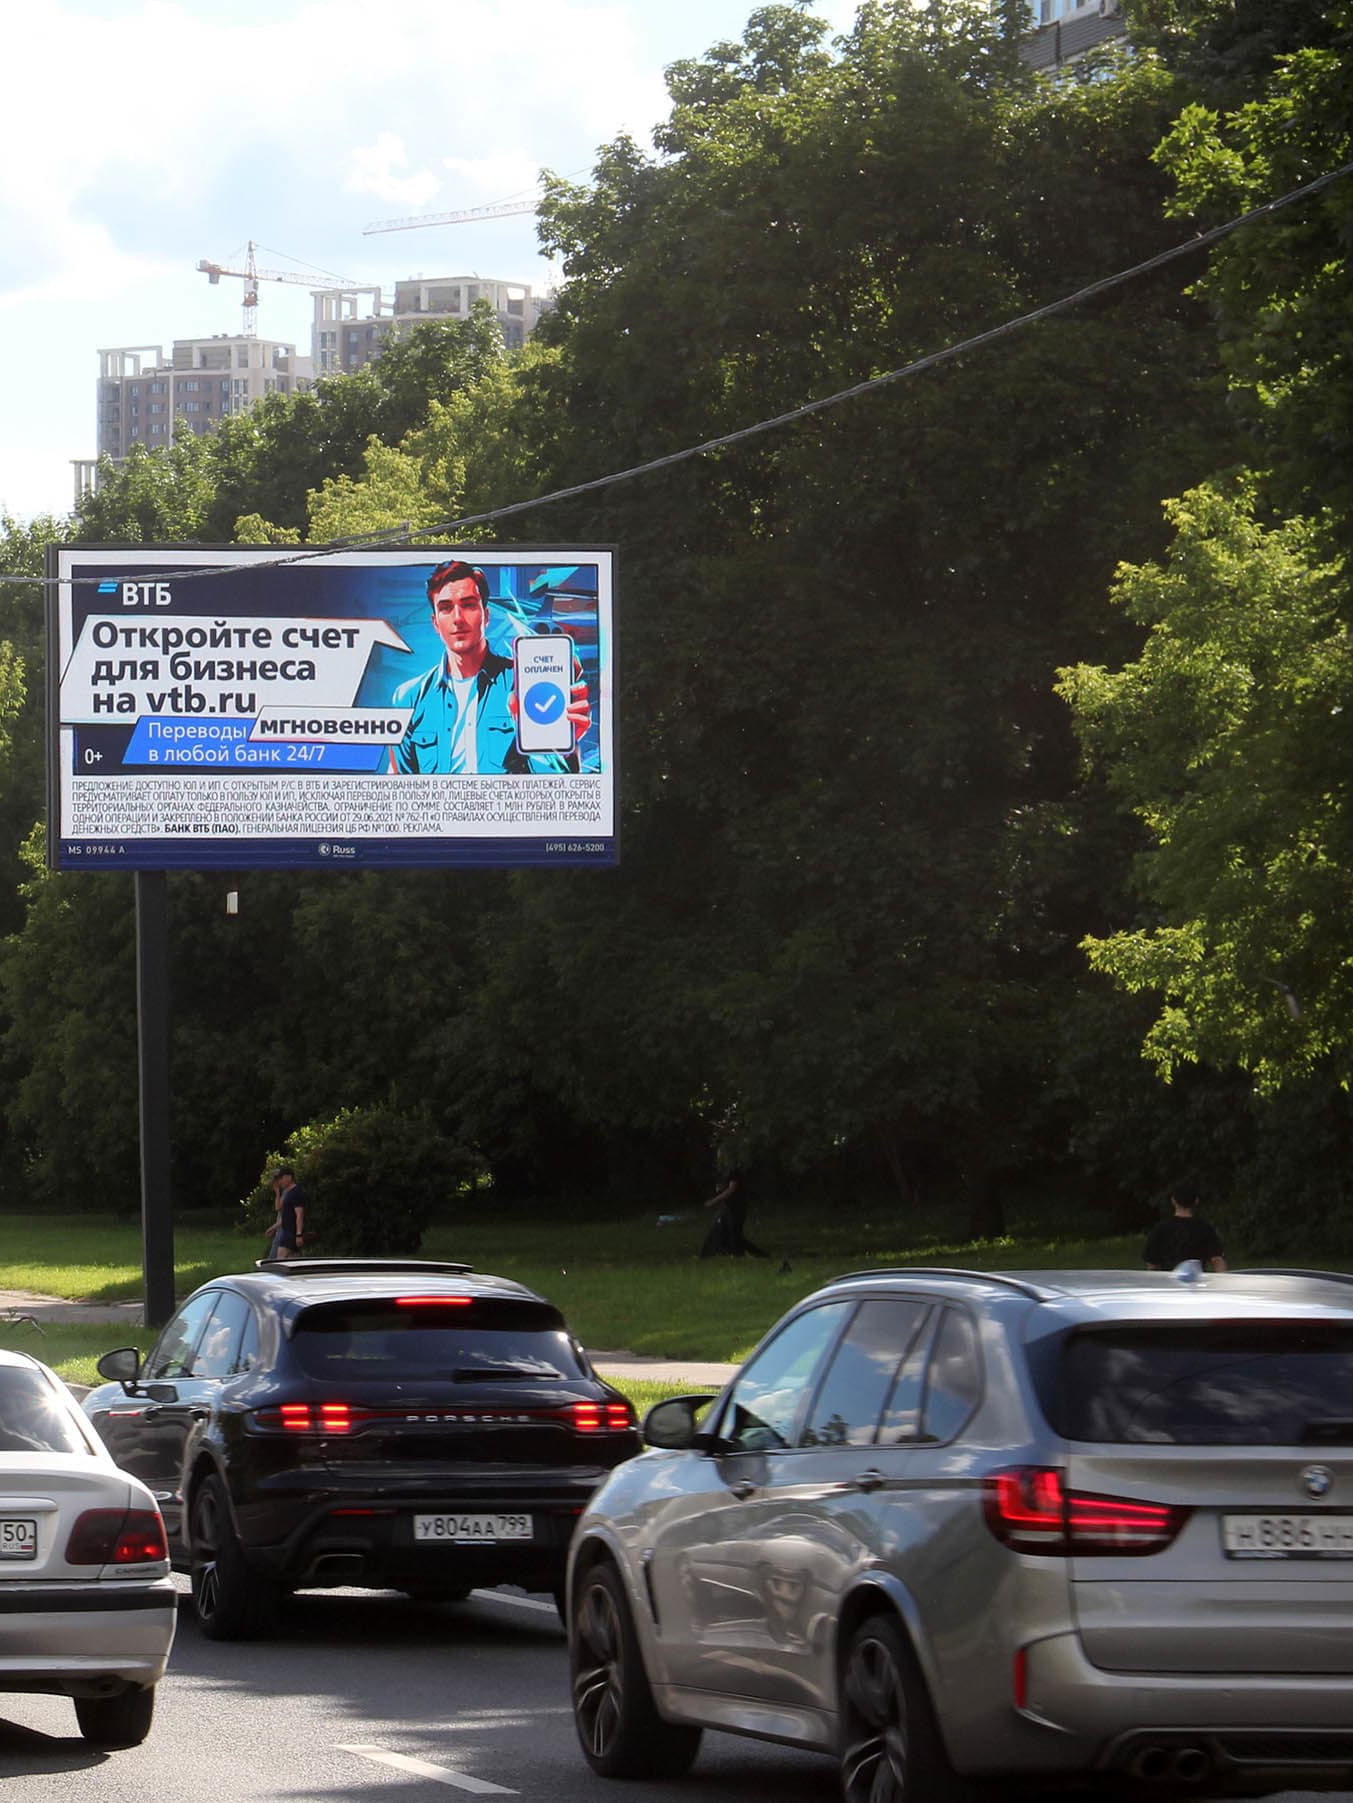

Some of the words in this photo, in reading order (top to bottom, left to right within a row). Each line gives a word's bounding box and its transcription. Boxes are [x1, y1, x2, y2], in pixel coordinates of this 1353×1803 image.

[122, 582, 172, 606] ВТБ
[92, 620, 272, 654] Откройте
[285, 627, 360, 649] счет
[91, 657, 159, 686] для
[169, 651, 316, 681] бизнеса
[92, 692, 136, 714] на
[146, 684, 256, 714] vtb.ru
[148, 723, 247, 744] Переводы
[259, 716, 402, 737] мгновенно
[84, 749, 103, 765] 0+
[148, 748, 159, 762] в
[165, 743, 227, 765] любой
[234, 744, 281, 762] банк
[287, 744, 325, 764] 24/7
[72, 781, 134, 792] ПРЕДЛОЖЕНИЕ
[136, 781, 180, 792] ДОСТУПНО
[232, 781, 278, 790] ОТКРЫТЫМ
[281, 781, 295, 790] Р/С
[306, 781, 320, 790] ВТБ
[331, 780, 430, 790] ЗАРЕГИСТРИРОВАННЫМ
[440, 780, 478, 790] СИСТЕМЕ
[480, 780, 520, 790] БЫСТРЫХ
[522, 779, 567, 790] ПЛАТЕЖЕЙ.
[570, 780, 600, 789] СЕРВИС
[72, 792, 151, 803] ПРЕДУСМАТРИВАЕТ
[153, 792, 184, 801] ОПЛАТУ
[187, 792, 218, 801] ТОЛЬКО
[227, 792, 258, 801] ПОЛЬЗУ
[282, 792, 296, 802] ИП,
[299, 792, 344, 801] ИСКЛЮЧАЯ
[347, 791, 390, 802] ПЕРЕВОДЫ
[399, 791, 430, 800] ПОЛЬЗУ
[431, 791, 447, 801] ЮЛ,
[449, 791, 487, 801] ЛИЦЕВЫЕ
[489, 791, 512, 800] СЧЕТА
[515, 791, 553, 800] КОТОРЫХ
[554, 791, 594, 800] ОТКРЫТЫ
[72, 803, 153, 812] ТЕРРИТОРИАЛЬНЫХ
[157, 803, 194, 812] ОРГАНАХ
[198, 803, 261, 813] ФЕДЕРАЛЬНОГО
[266, 801, 330, 812] КАЗНАЧЕЙСТВА.
[334, 802, 392, 812] ОГРАНИЧЕНИЕ
[411, 802, 440, 811] СУММЕ
[444, 802, 493, 811] СОСТАВЛЯЕТ
[504, 802, 523, 811] МЛН
[526, 800, 556, 811] РУБЛЕЙ
[568, 802, 600, 811] РАМКАХ
[72, 812, 103, 824] ОДНОЙ
[105, 814, 150, 824] ОПЕРАЦИИ
[160, 814, 212, 823] ЗАКРЕПЛЕНО
[221, 813, 274, 823] ПОЛОЖЕНИИ
[276, 813, 302, 822] БАНКА
[305, 813, 338, 822] РОССИИ
[352, 813, 394, 822] 29.06.2021
[406, 813, 429, 822] 762-П
[442, 813, 485, 822] ПРАВИЛАХ
[486, 813, 557, 822] ОСУЩЕСТВЛЕНИЯ
[559, 812, 600, 822] ПЕРЕВОДА
[72, 825, 119, 835] ДЕНЕЖНЫХ
[121, 824, 162, 835] СРЕДСТВ».
[165, 824, 191, 834] БАНК
[193, 824, 210, 833] ВТБ
[212, 824, 241, 833] (ПАО).
[243, 824, 298, 833] ГЕНЕРАЛЬНАЯ
[300, 824, 343, 834] ЛИЦЕНЗИЯ
[372, 824, 401, 833] №1000.
[403, 824, 443, 832] РЕКЛАМА.
[86, 846, 116, 854] 09944
[333, 845, 355, 854] Russ
[546, 843, 566, 852] (495)
[568, 843, 605, 852] 626-5200
[3, 1524, 26, 1541] 50
[421, 1517, 496, 1536] У804АА
